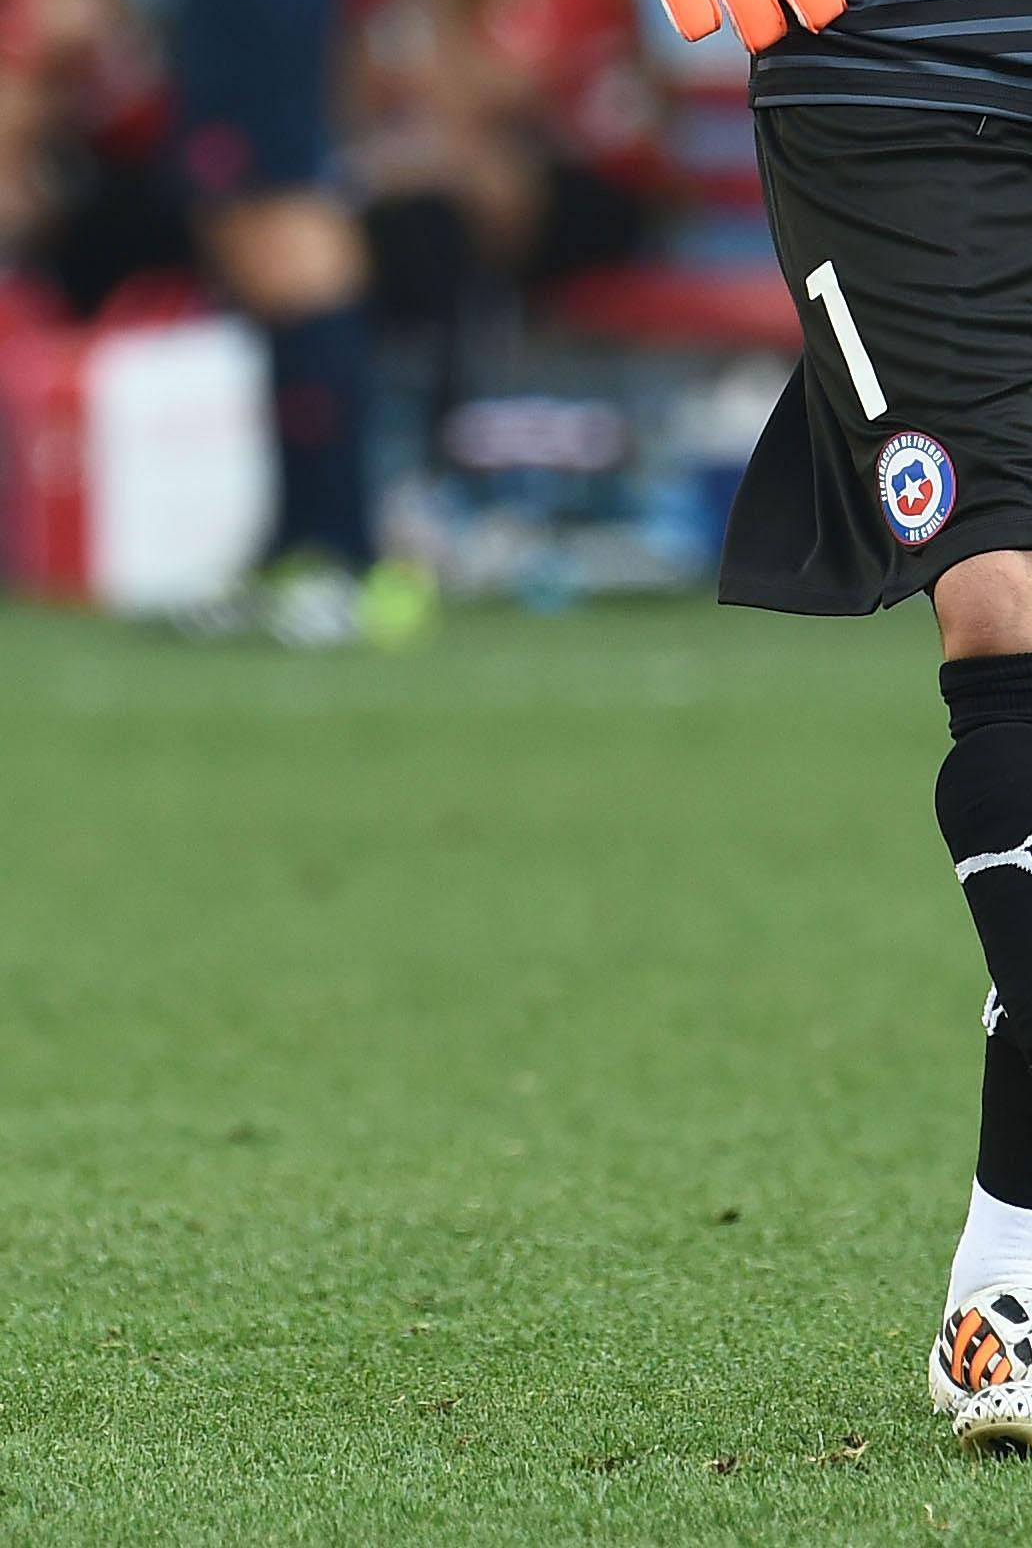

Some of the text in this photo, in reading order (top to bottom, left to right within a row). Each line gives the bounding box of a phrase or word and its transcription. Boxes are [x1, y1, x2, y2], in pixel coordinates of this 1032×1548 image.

[805, 260, 888, 421] 1
[909, 512, 944, 542] DE CHILE
